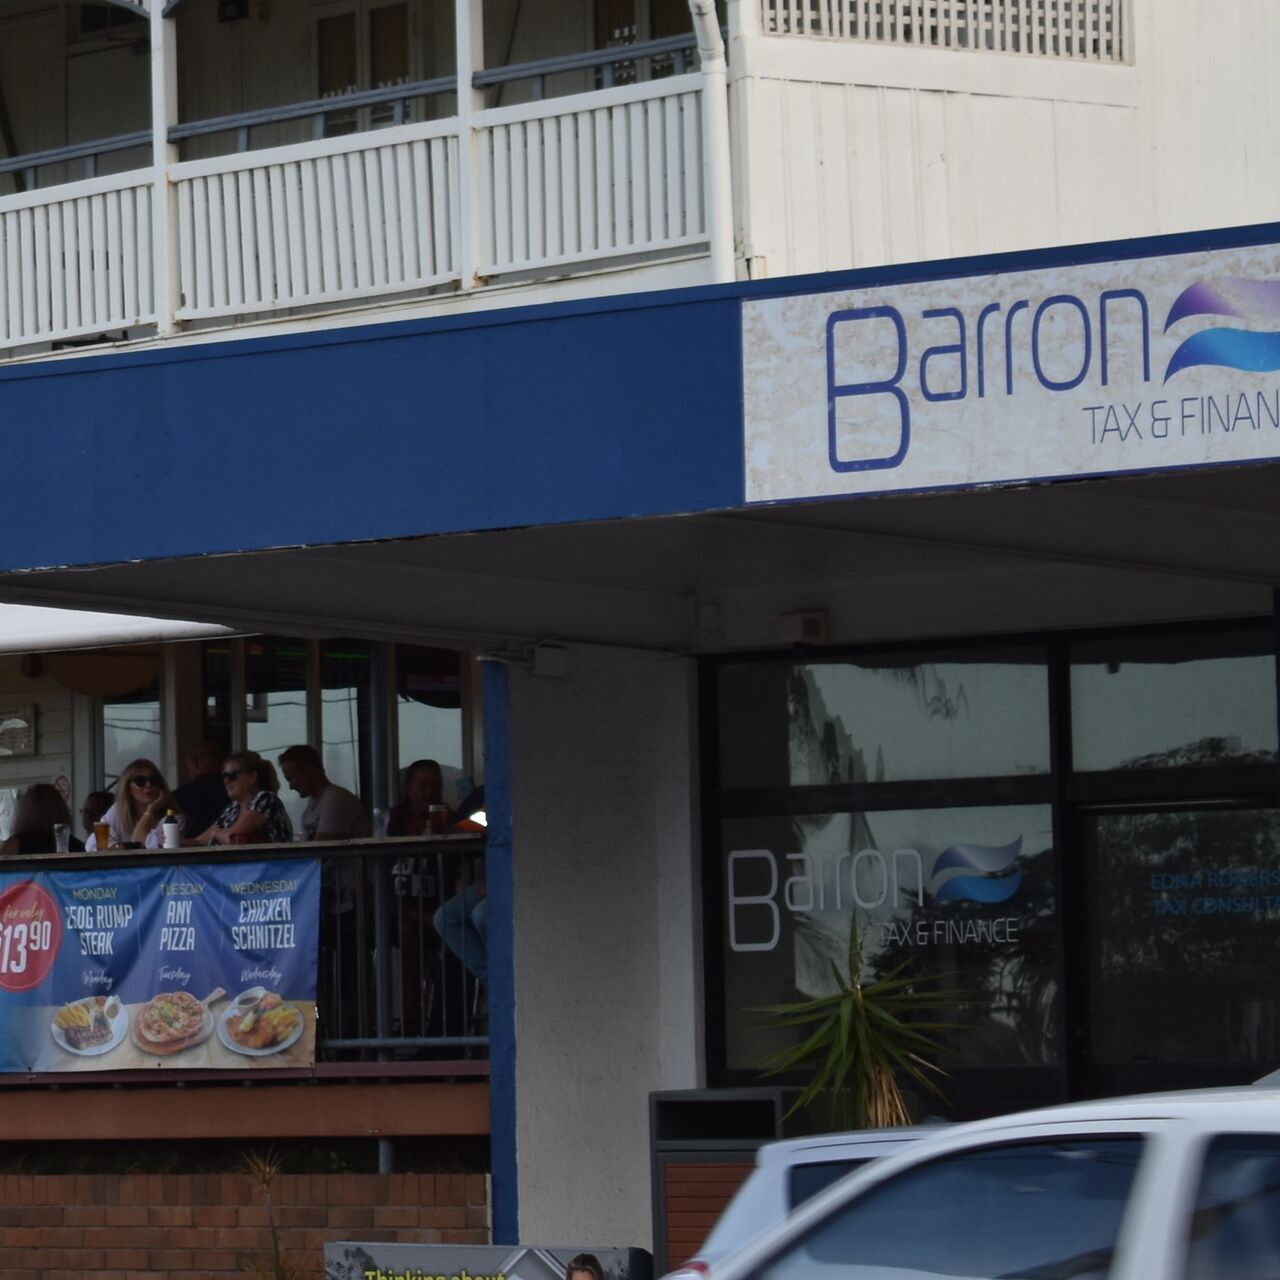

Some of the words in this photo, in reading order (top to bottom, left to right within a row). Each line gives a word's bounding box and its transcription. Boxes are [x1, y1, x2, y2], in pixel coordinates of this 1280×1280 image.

[826, 288, 1151, 473] Barron
[1082, 402, 1144, 444] TAX
[1151, 400, 1171, 439] &
[72, 887, 117, 900] MONDAY
[160, 883, 206, 896] TUESDAY
[230, 879, 300, 895] WEDNESDAY
[3, 905, 19, 920] for
[20, 902, 45, 921] only
[166, 900, 193, 924] ANY
[238, 897, 292, 924] CHICKEN
[727, 848, 924, 952] Barron
[1153, 897, 1186, 915] TAX
[96, 904, 133, 928] RUMP
[79, 931, 114, 956] STEAK
[159, 927, 196, 951] PIZZA
[231, 923, 297, 951] SCHNITZEL
[880, 921, 913, 946] TAX
[916, 921, 929, 946] &
[934, 917, 1020, 946] FINANCE
[159, 965, 192, 986] Tuesday
